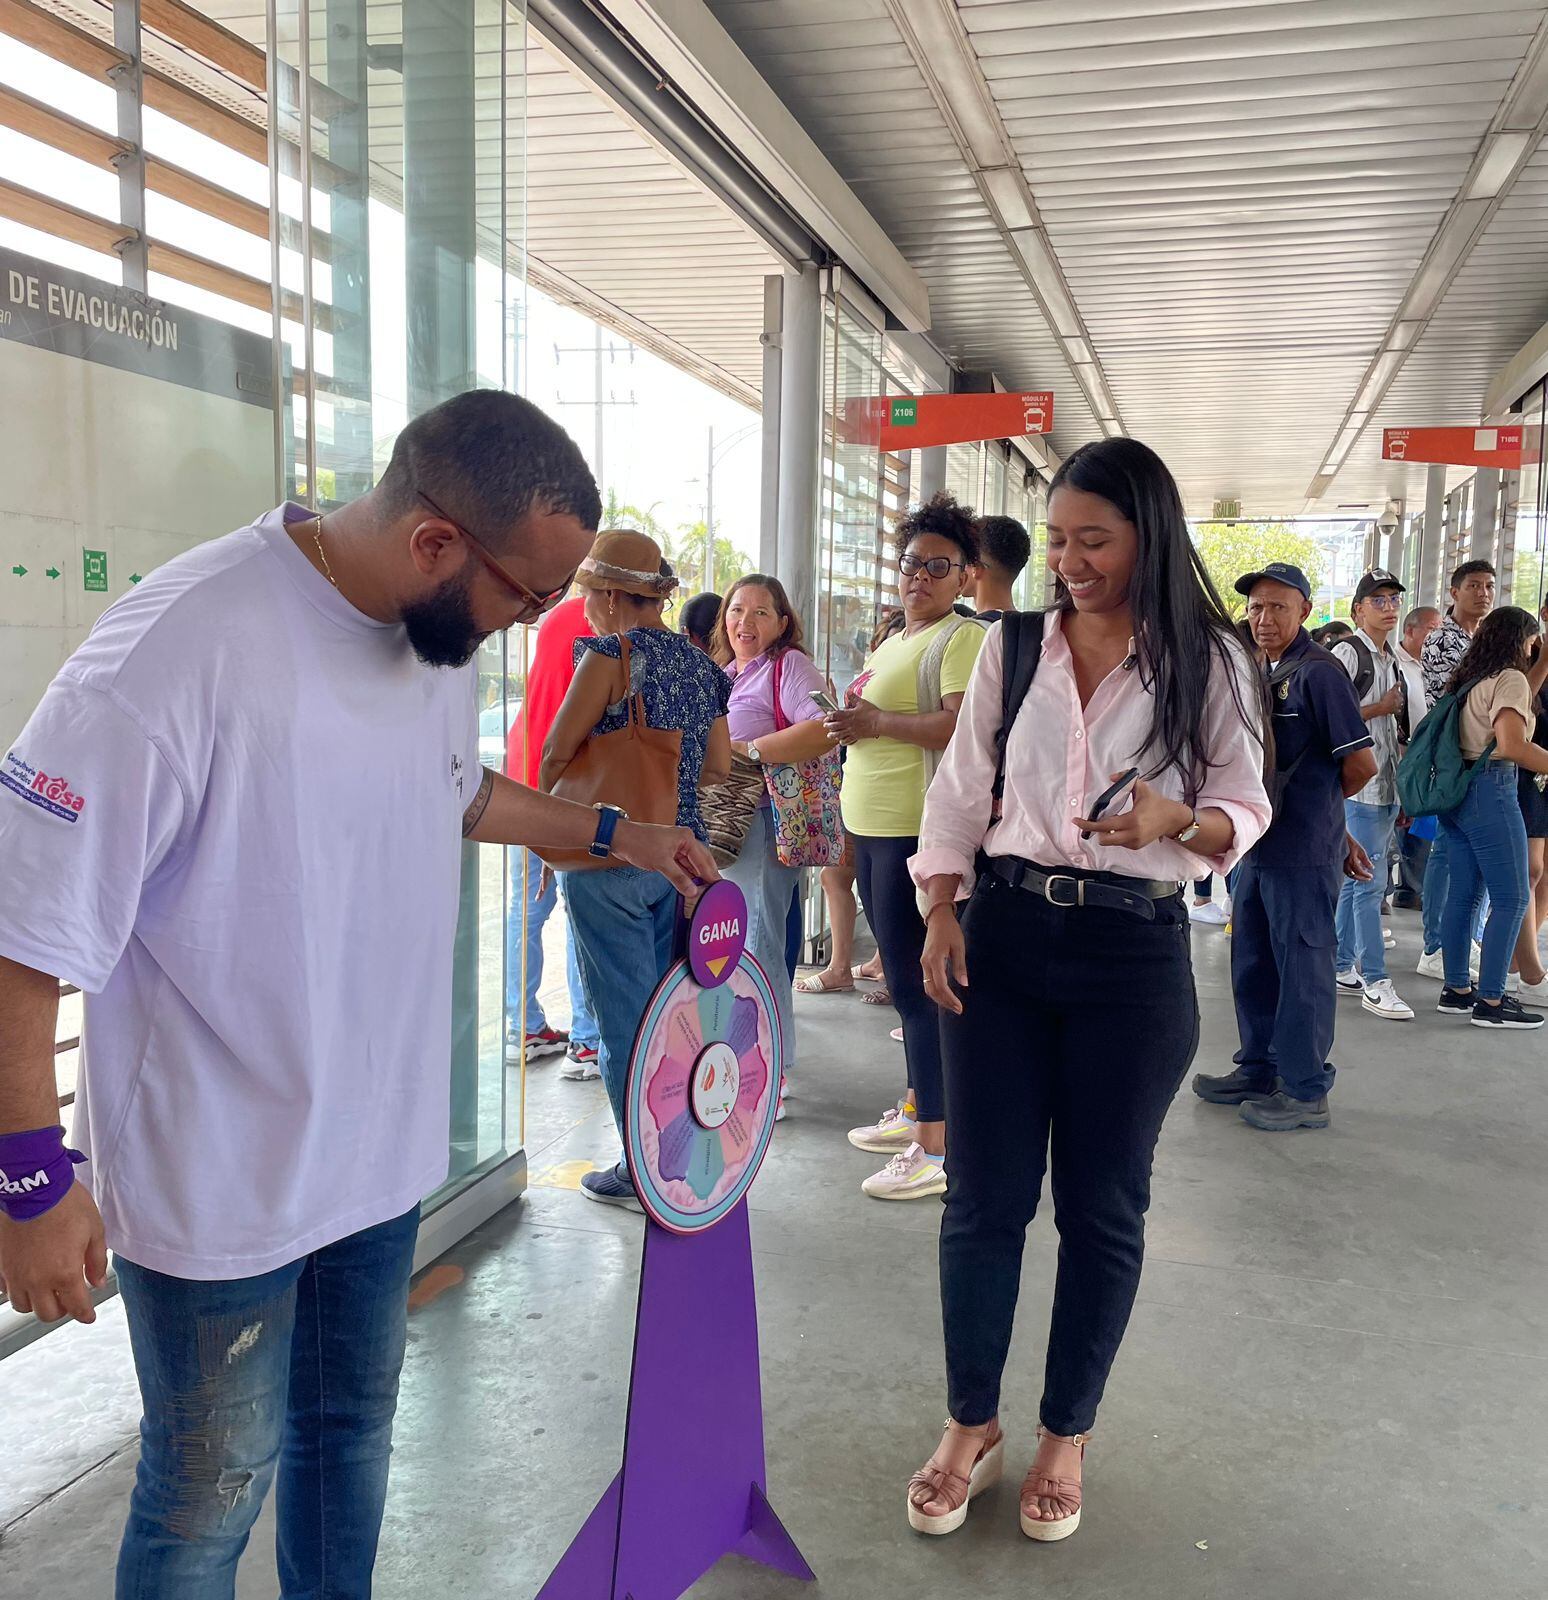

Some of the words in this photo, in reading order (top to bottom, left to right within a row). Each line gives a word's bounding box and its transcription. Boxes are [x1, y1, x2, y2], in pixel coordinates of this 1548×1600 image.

[9, 270, 40, 309] DE
[48, 282, 178, 351] EVACUACIÓN
[700, 918, 740, 945] GANA
